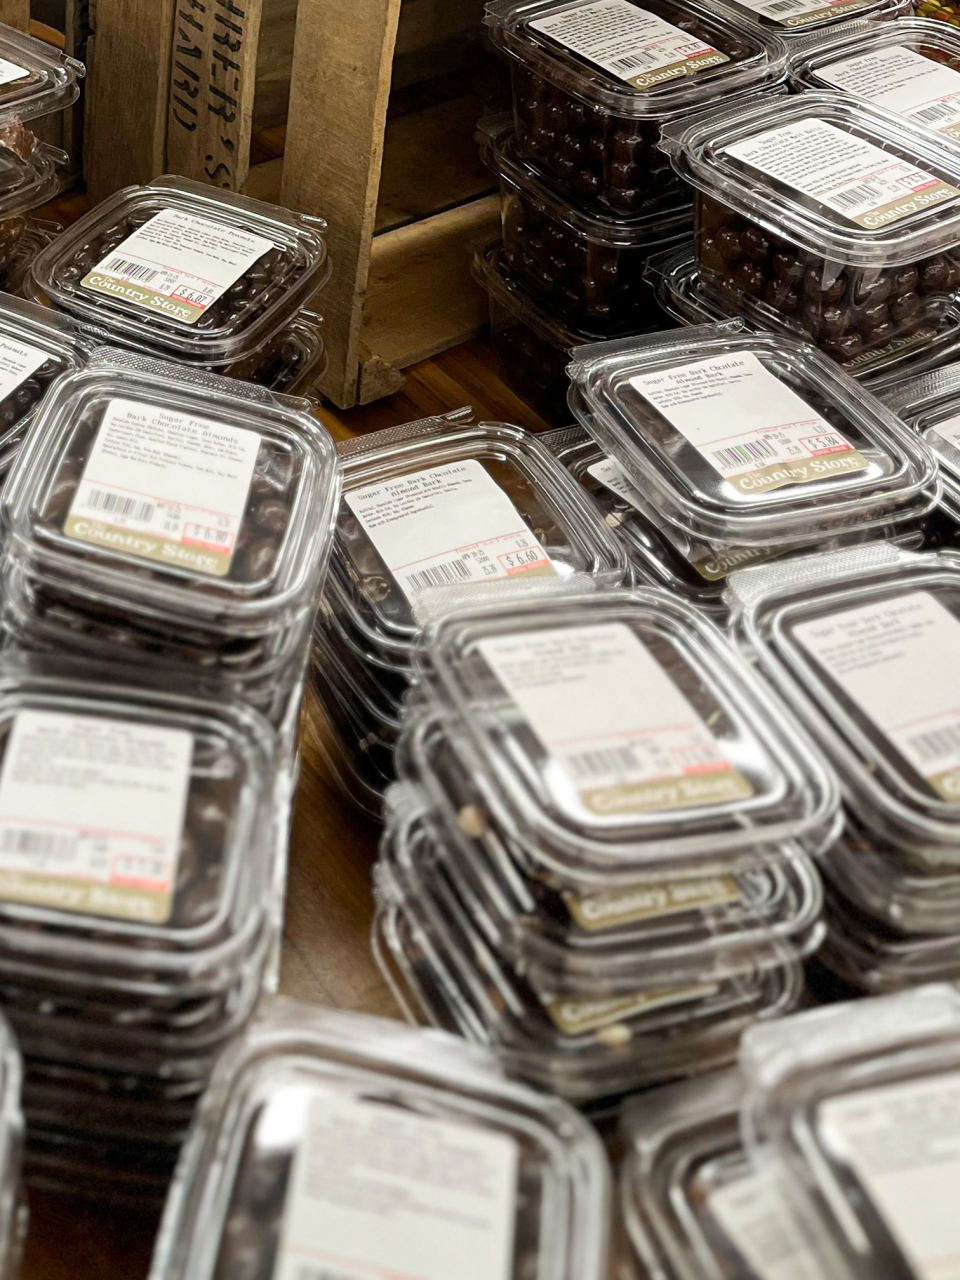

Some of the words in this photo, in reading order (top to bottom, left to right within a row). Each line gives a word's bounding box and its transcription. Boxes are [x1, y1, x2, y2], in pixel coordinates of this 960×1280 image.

[787, 10, 833, 27] Country
[832, 2, 863, 15] Store
[636, 65, 688, 87] Country
[686, 55, 721, 69] Store
[846, 60, 864, 69] Sugar
[864, 56, 879, 65] Free
[758, 135, 777, 147] Sugar
[777, 130, 793, 140] Free
[758, 137, 790, 154] Chocolate
[788, 131, 805, 142] Malt
[805, 126, 823, 138] Balls
[863, 199, 919, 226] Country
[913, 187, 954, 205] Store
[190, 217, 226, 233] Chocolate
[227, 229, 256, 244] Peanuts
[90, 274, 150, 302] Country
[150, 295, 192, 318] Store
[179, 287, 189, 297] $
[186, 291, 208, 303] 6.07
[842, 344, 895, 368] Country
[642, 374, 666, 387] Sugar
[667, 371, 687, 382] Free
[675, 373, 703, 385] Almond
[158, 412, 185, 426] Sugar
[188, 419, 211, 431] Free
[151, 418, 199, 436] Chocolate
[201, 429, 239, 445] Almonds
[807, 439, 818, 450] $
[820, 435, 840, 448] 5.84
[739, 466, 809, 490] Country
[809, 455, 857, 473] Store
[745, 471, 761, 480] The
[357, 489, 381, 502] Sugar
[384, 483, 405, 494] Free
[390, 484, 420, 498] Almond
[422, 479, 443, 491] Bark
[194, 525, 200, 535] $
[204, 528, 228, 542] 6.80
[73, 523, 158, 552] Country
[161, 542, 219, 568] Store
[505, 555, 515, 567] $
[515, 549, 539, 565] 6.60
